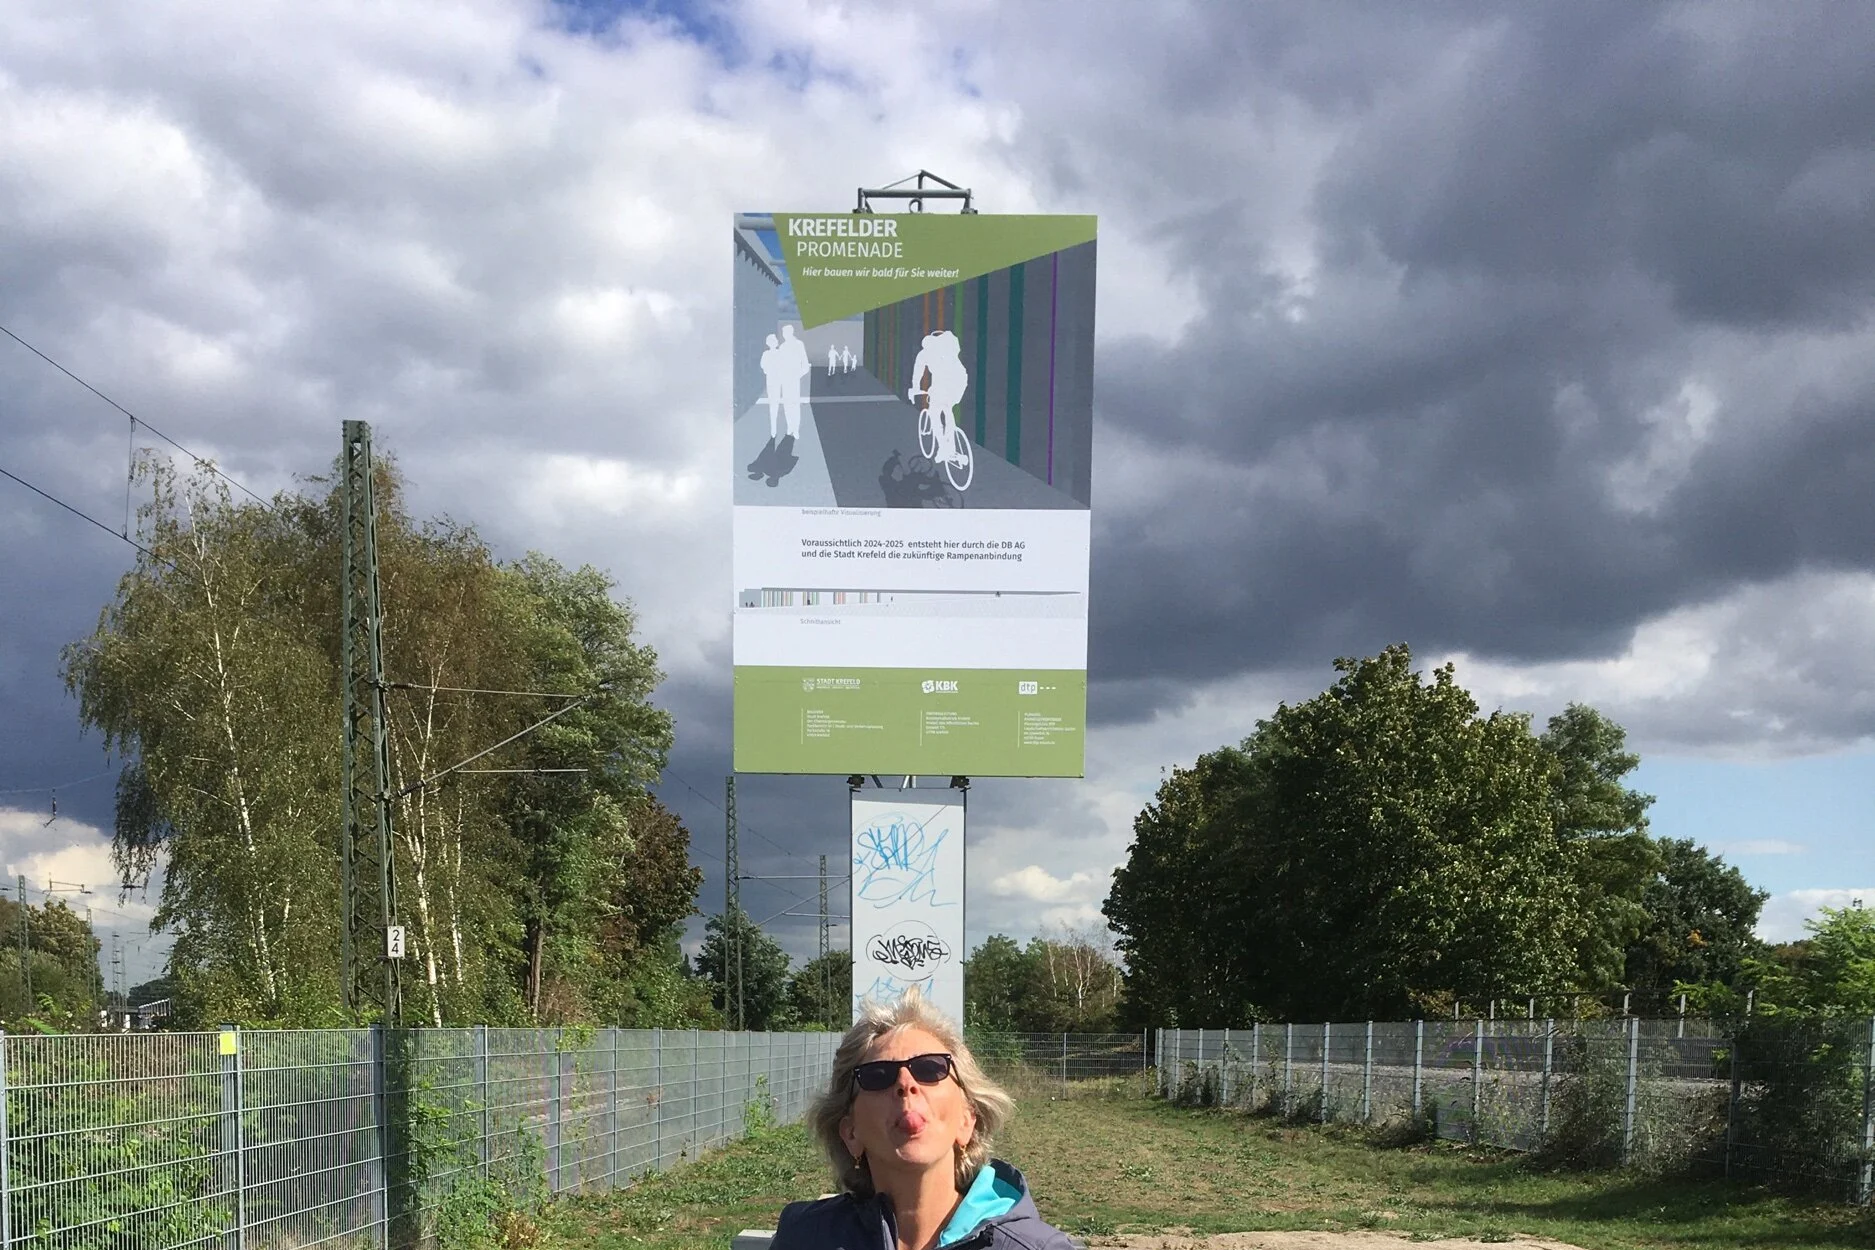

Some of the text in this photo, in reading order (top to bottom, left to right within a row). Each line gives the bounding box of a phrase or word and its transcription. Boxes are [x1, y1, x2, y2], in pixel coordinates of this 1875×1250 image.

[788, 218, 898, 238] KREFELDER
[797, 241, 904, 258] PROMENADE
[802, 266, 960, 280] Hier bauen wir bald für Sie weiter!
[801, 538, 1026, 550] Voraussichtlich 2024-2025 entsteht hier durch die DB AG
[801, 549, 1023, 563] und die Stadt Krefeld die zukünftige Rampenanbindung
[816, 678, 835, 686] STADT
[935, 680, 959, 692] KBK
[1020, 683, 1036, 694] dtp
